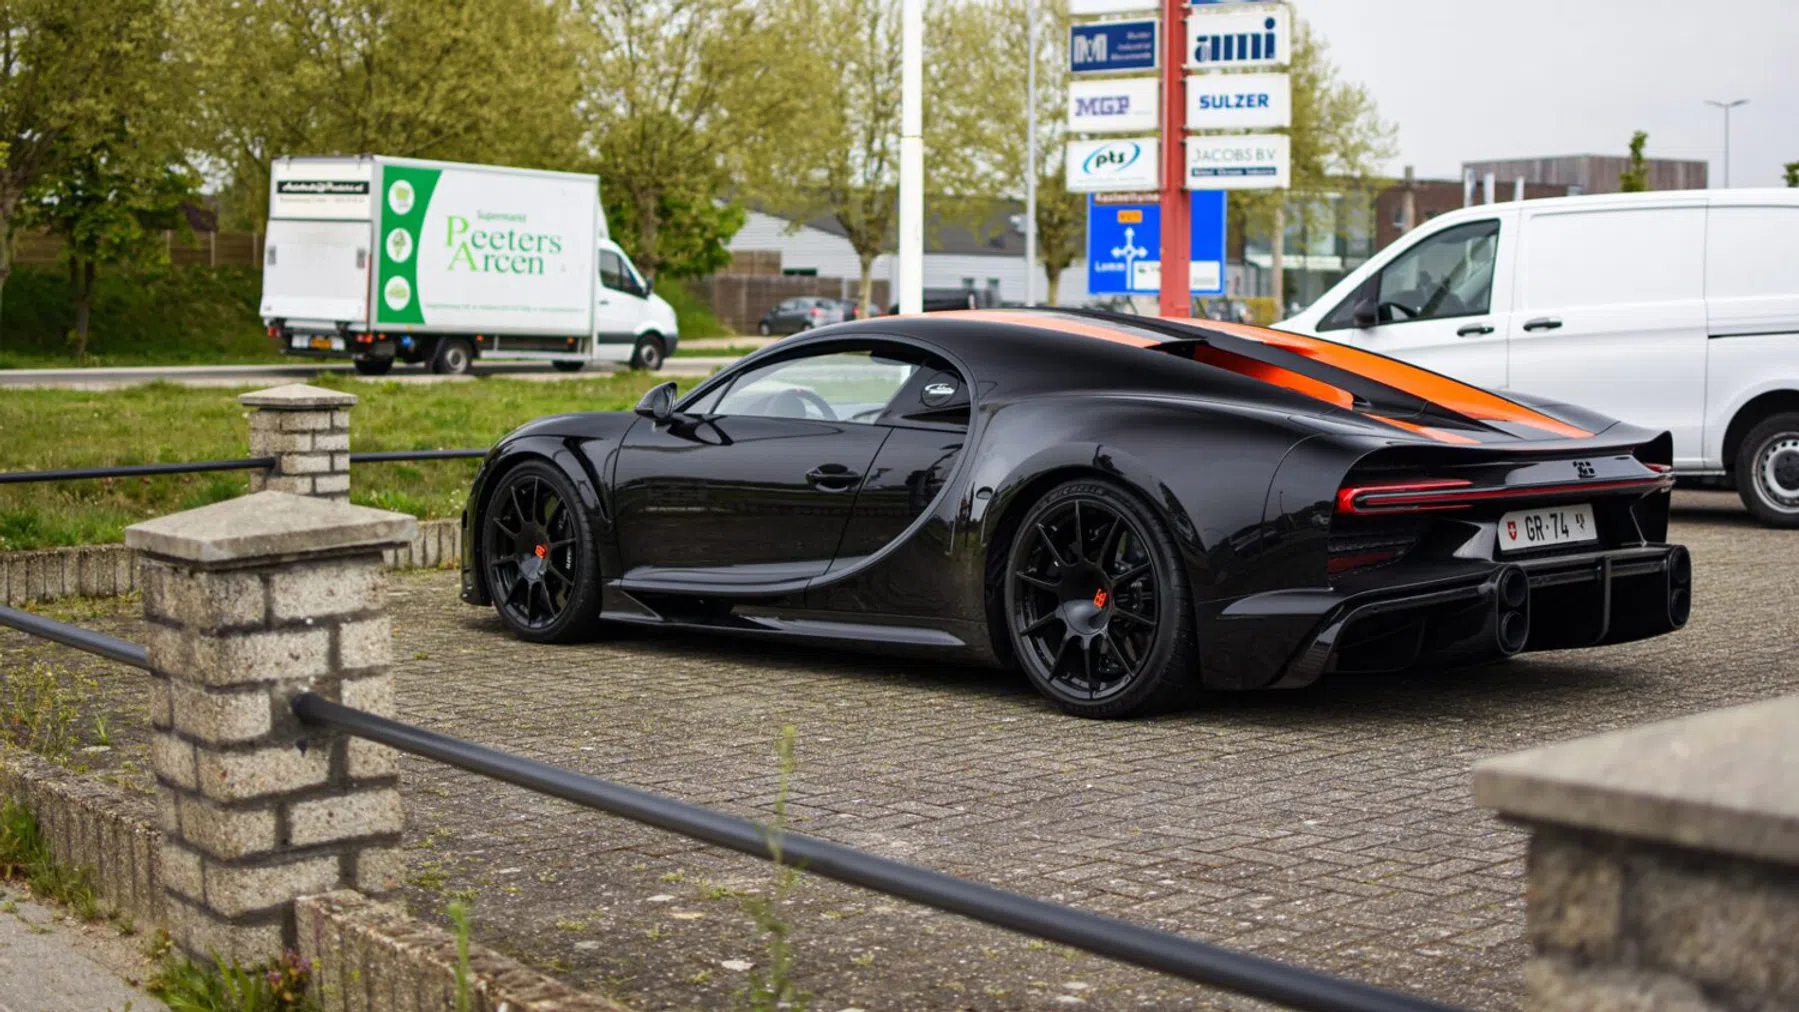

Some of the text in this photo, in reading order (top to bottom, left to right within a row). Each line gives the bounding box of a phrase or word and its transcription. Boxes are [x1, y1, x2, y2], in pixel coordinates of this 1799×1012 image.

[1075, 96, 1130, 116] MGP
[1199, 94, 1269, 109] SULZER
[1096, 151, 1126, 168] pts
[1192, 148, 1252, 163] JACOBS
[445, 215, 563, 253] Peeters
[446, 240, 545, 275] Arcen
